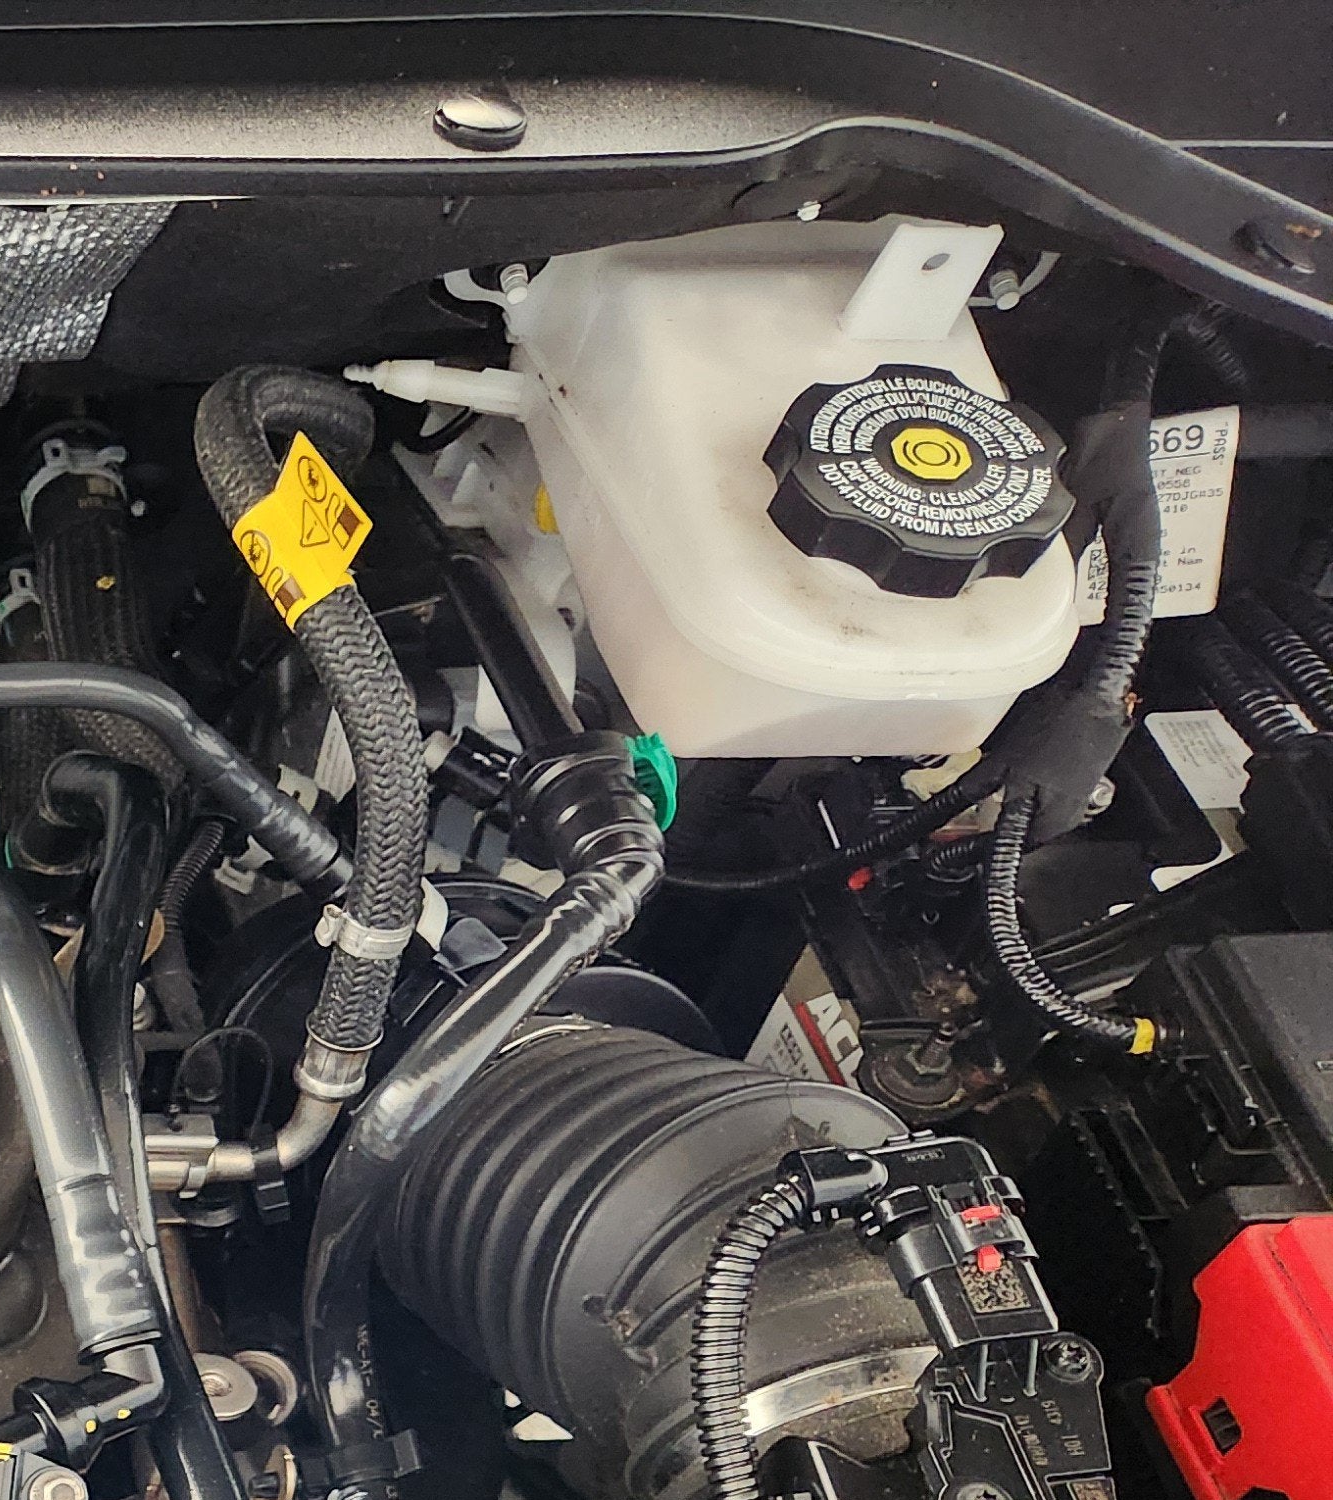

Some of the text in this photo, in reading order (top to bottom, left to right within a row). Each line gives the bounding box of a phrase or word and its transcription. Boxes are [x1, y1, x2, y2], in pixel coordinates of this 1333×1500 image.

[860, 395, 890, 414] QUE
[884, 392, 907, 406] DU
[904, 391, 956, 411] LIQUIDE
[953, 401, 976, 418] DE
[970, 410, 1010, 438] FREIN
[886, 377, 907, 391] LE
[906, 378, 970, 401] BOUCHON
[967, 394, 1013, 420] AVANT
[927, 406, 969, 430] BIDON
[962, 422, 1005, 459] SCELLE
[839, 460, 869, 482] CAP
[858, 480, 919, 515] BEFORE
[989, 489, 1019, 511] USE
[1005, 465, 1029, 494] ONLY
[929, 489, 982, 506] CLEAN
[973, 464, 1007, 497] FILLER
[844, 489, 892, 519] FLUID
[889, 511, 940, 536] FROM
[941, 522, 954, 536] A
[953, 515, 1013, 537] SEALED
